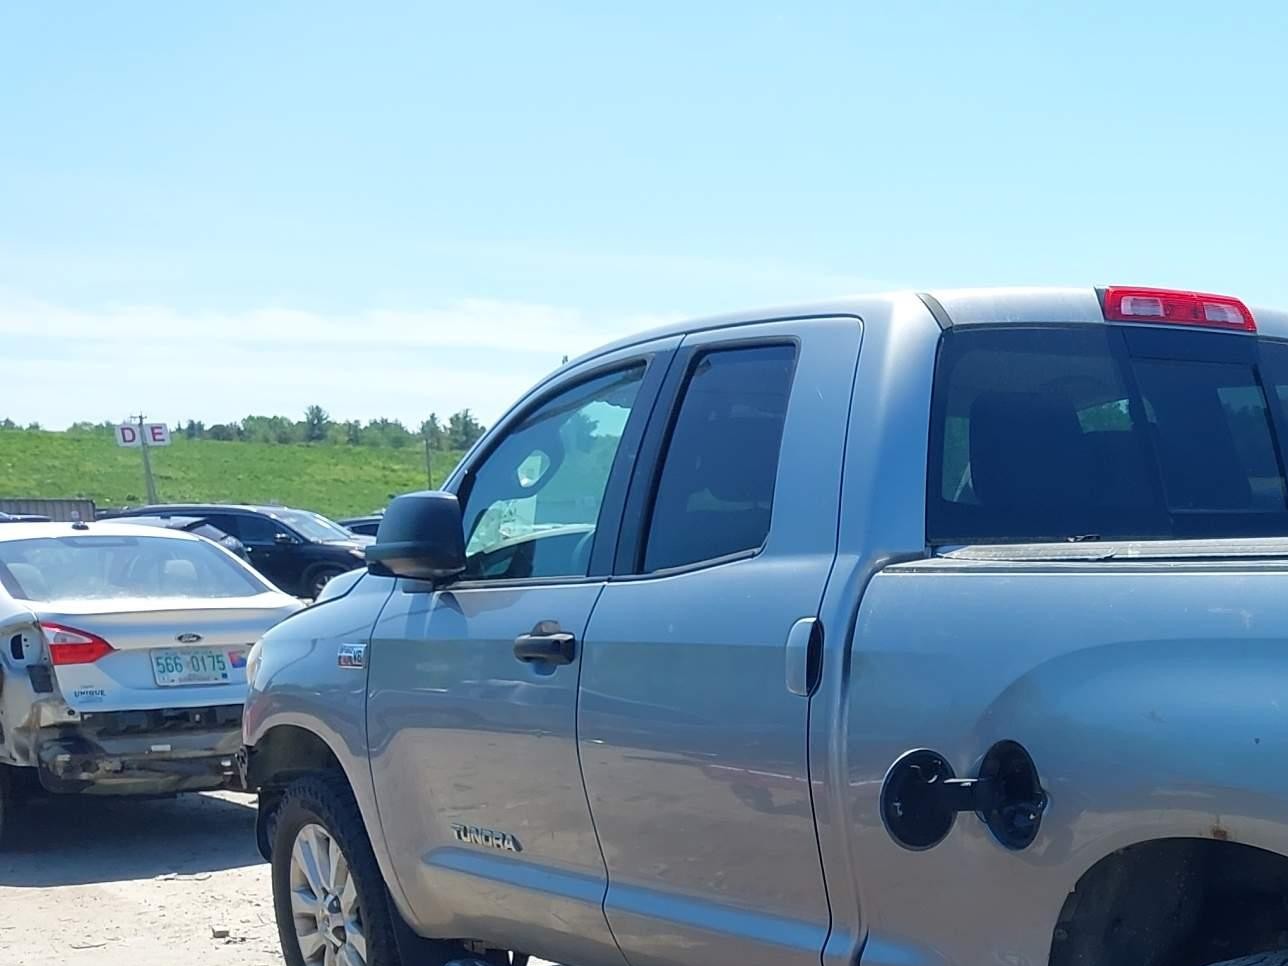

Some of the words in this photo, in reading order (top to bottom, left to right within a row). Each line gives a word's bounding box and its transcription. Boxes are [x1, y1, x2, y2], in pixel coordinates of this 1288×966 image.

[120, 427, 136, 443] D
[151, 426, 165, 442] E
[156, 655, 184, 674] 566
[189, 654, 226, 673] 0175
[450, 822, 523, 852] TUNDRA
